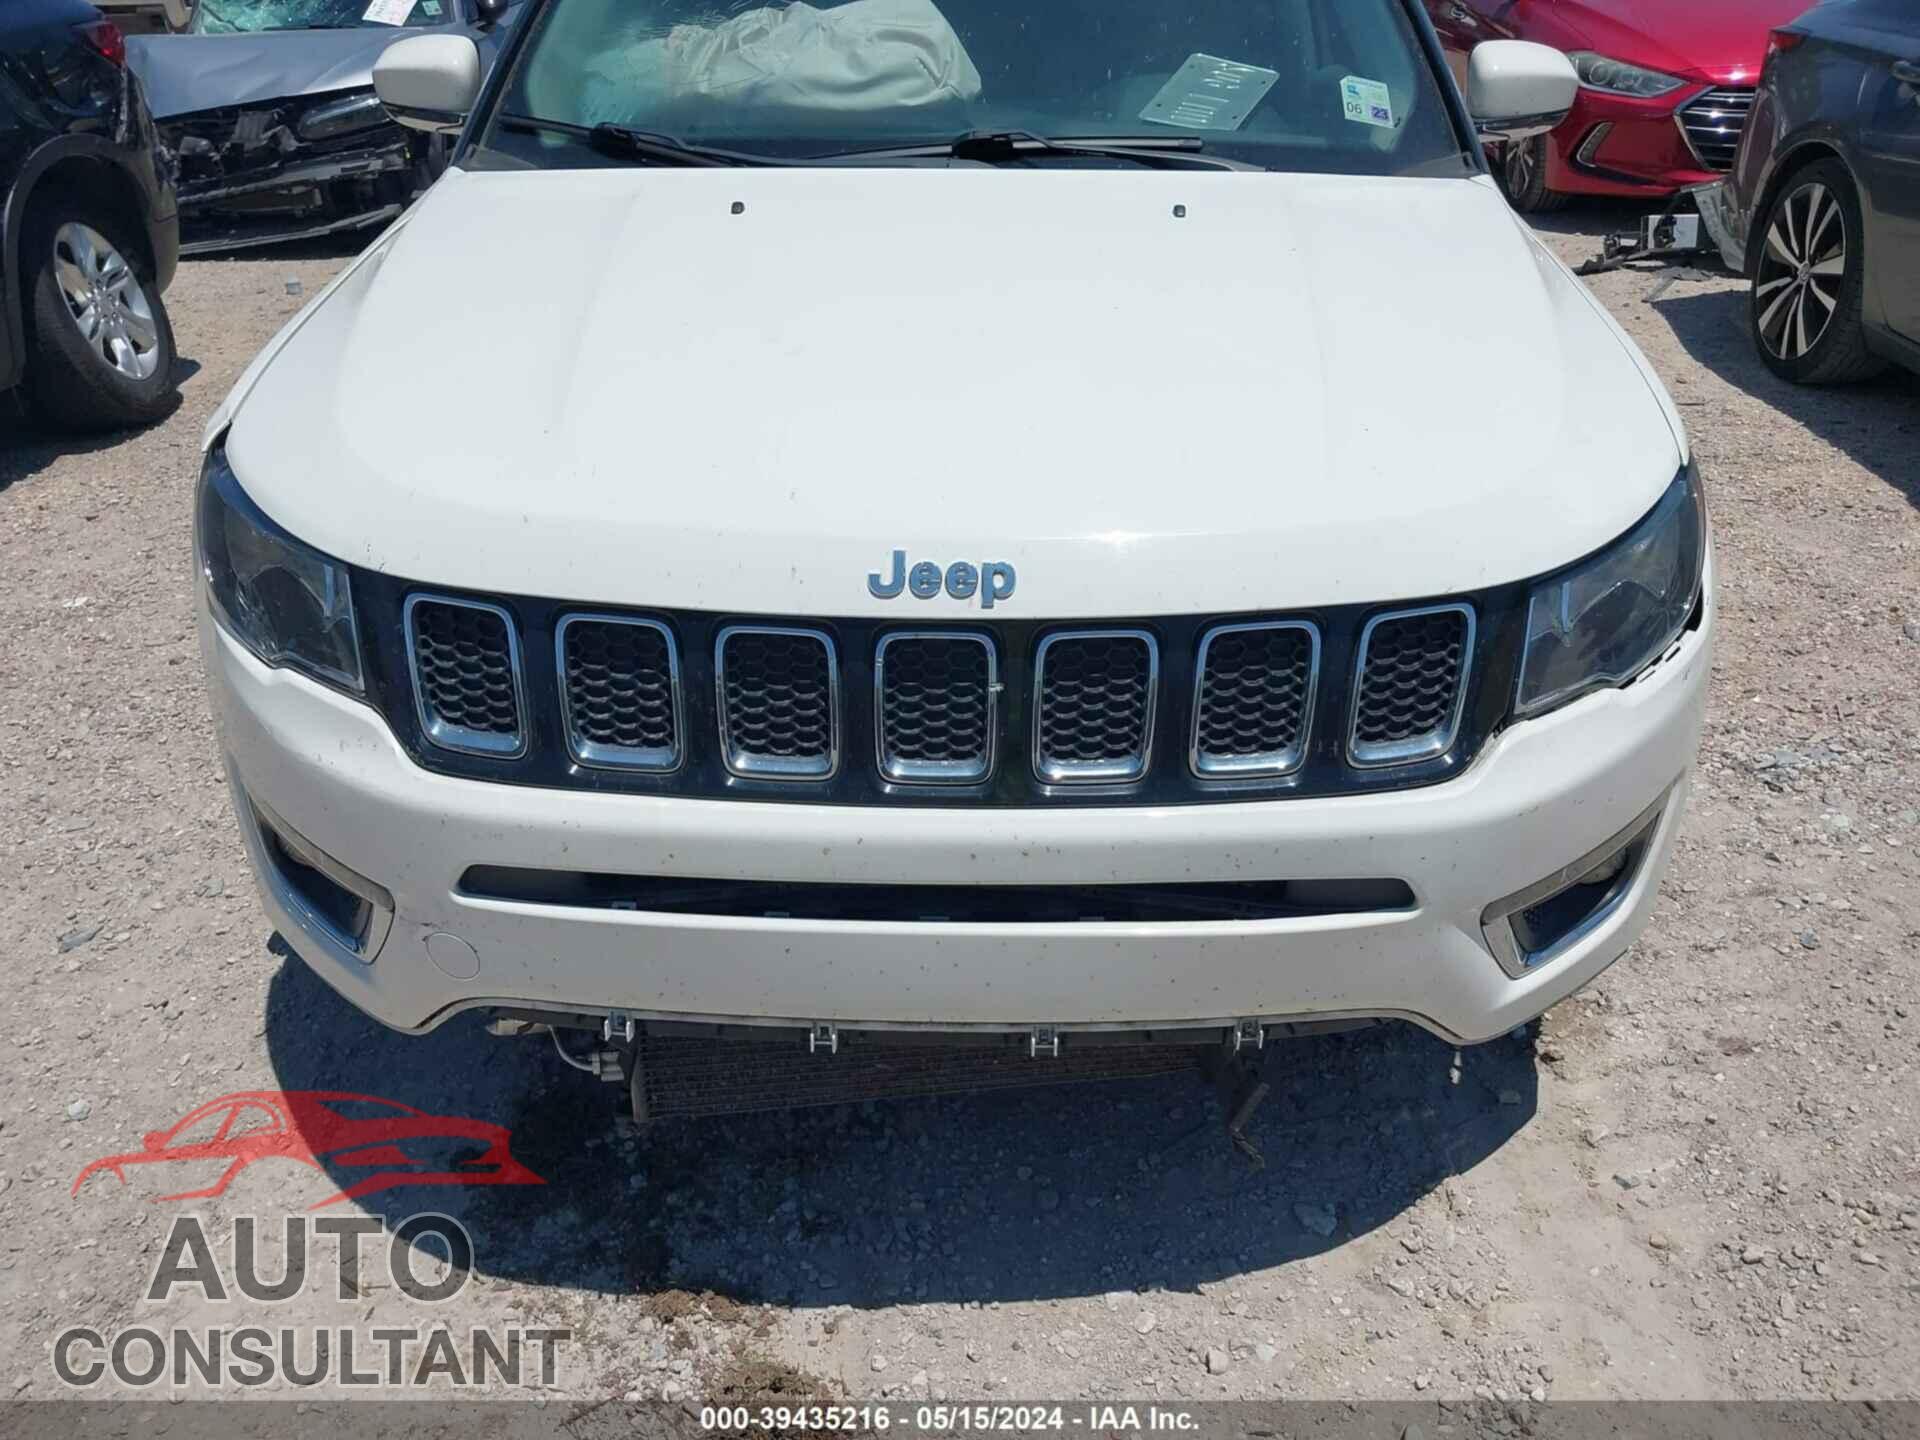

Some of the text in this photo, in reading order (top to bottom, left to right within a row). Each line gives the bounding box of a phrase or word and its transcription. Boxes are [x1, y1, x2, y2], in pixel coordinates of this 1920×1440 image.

[1346, 102, 1389, 119] 06 23
[867, 549, 1017, 609] Jeep
